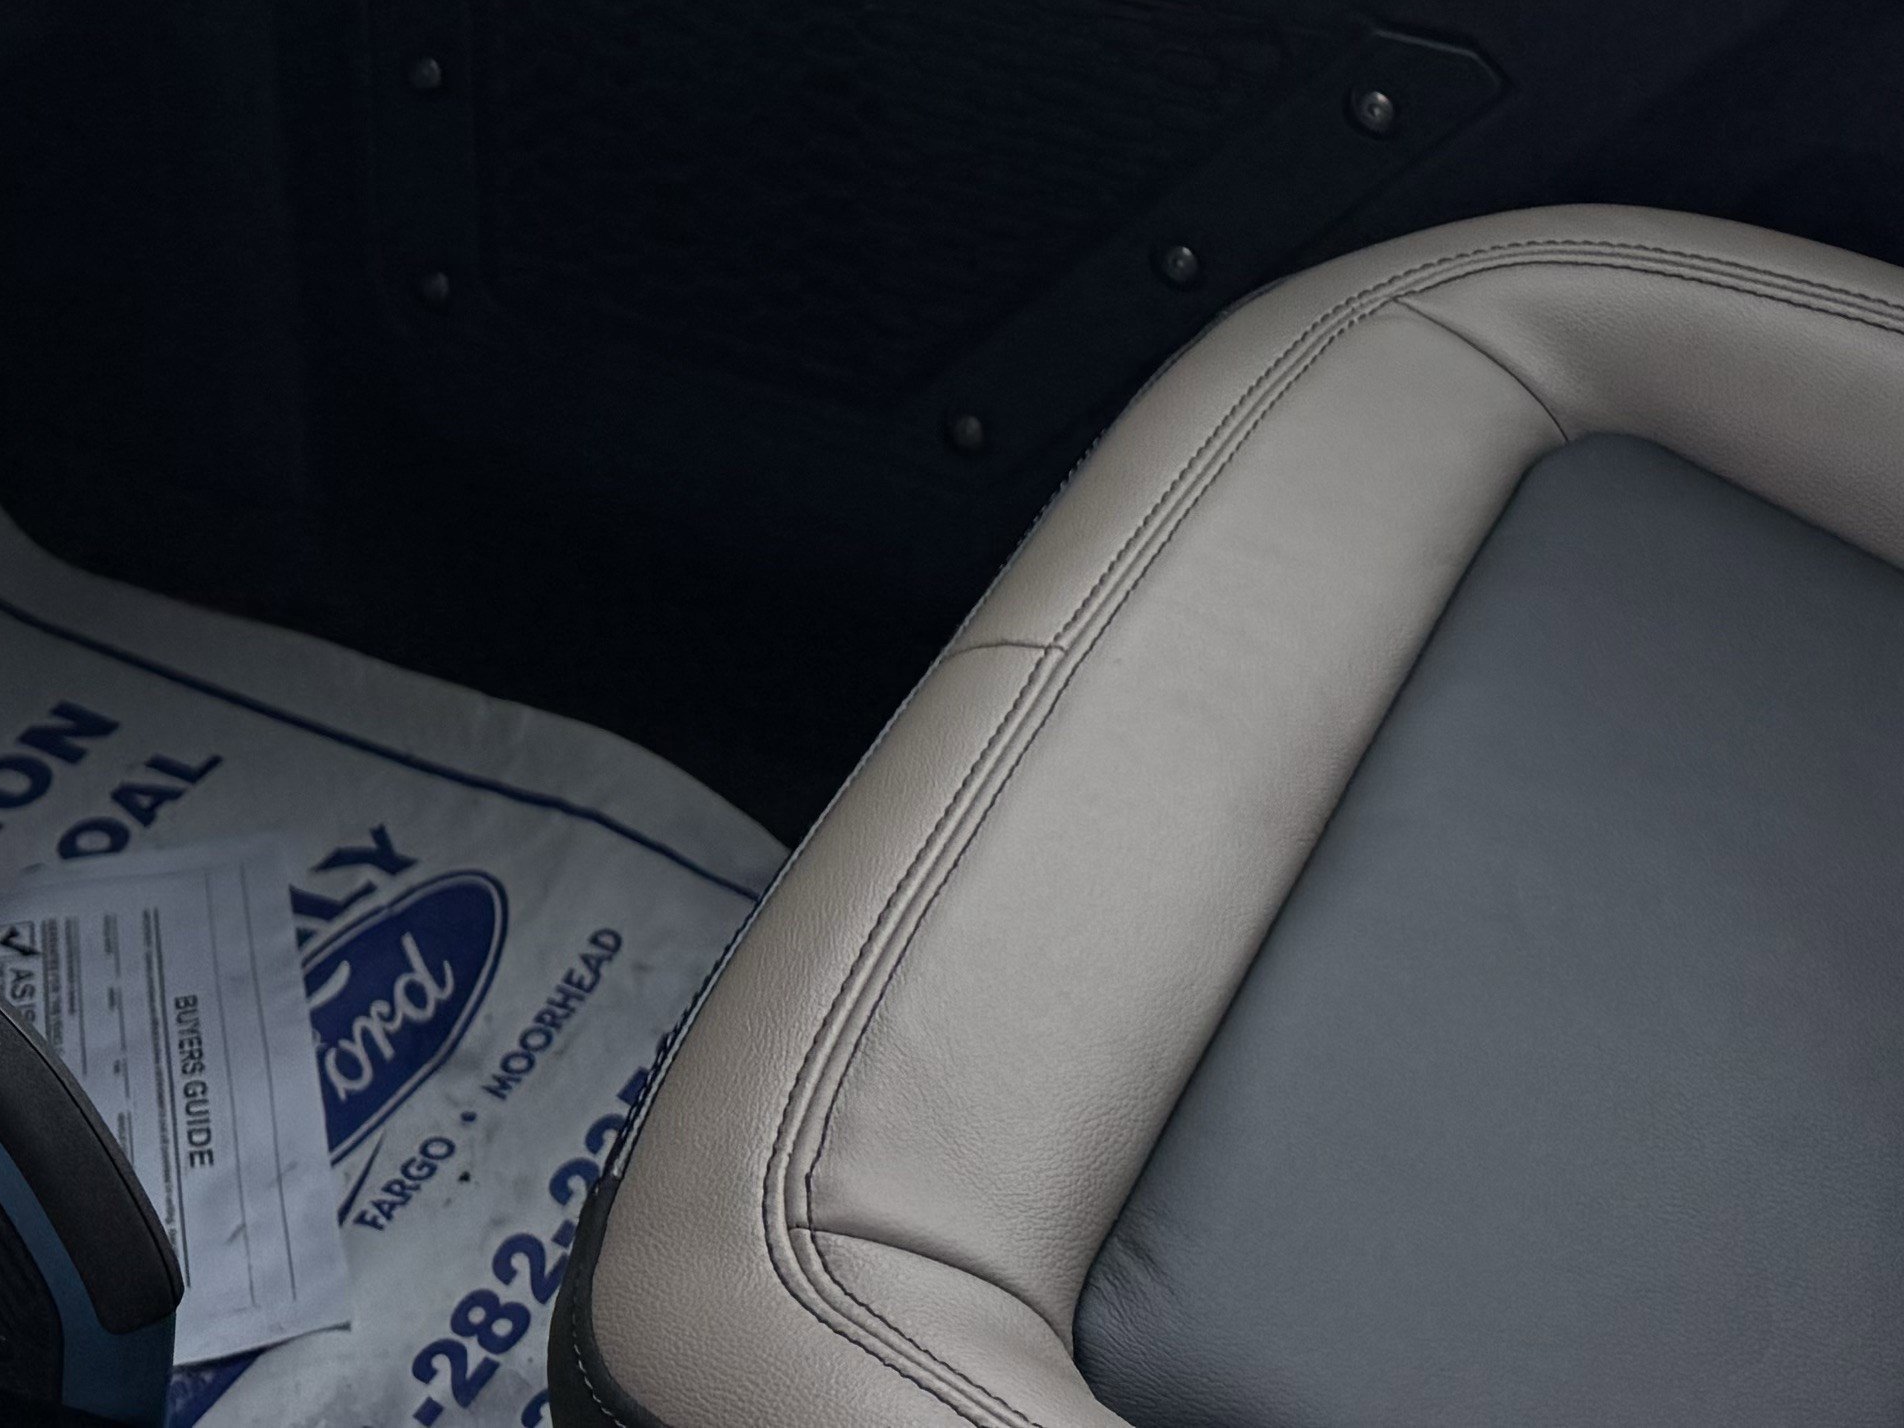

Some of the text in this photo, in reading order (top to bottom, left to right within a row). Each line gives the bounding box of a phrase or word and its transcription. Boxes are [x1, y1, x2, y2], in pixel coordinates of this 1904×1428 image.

[10, 968, 38, 1001] AS
[309, 931, 455, 1102] ord
[173, 993, 215, 1169] BUYERS GUIDE
[355, 925, 625, 1233] FARGO MOORHEAD
